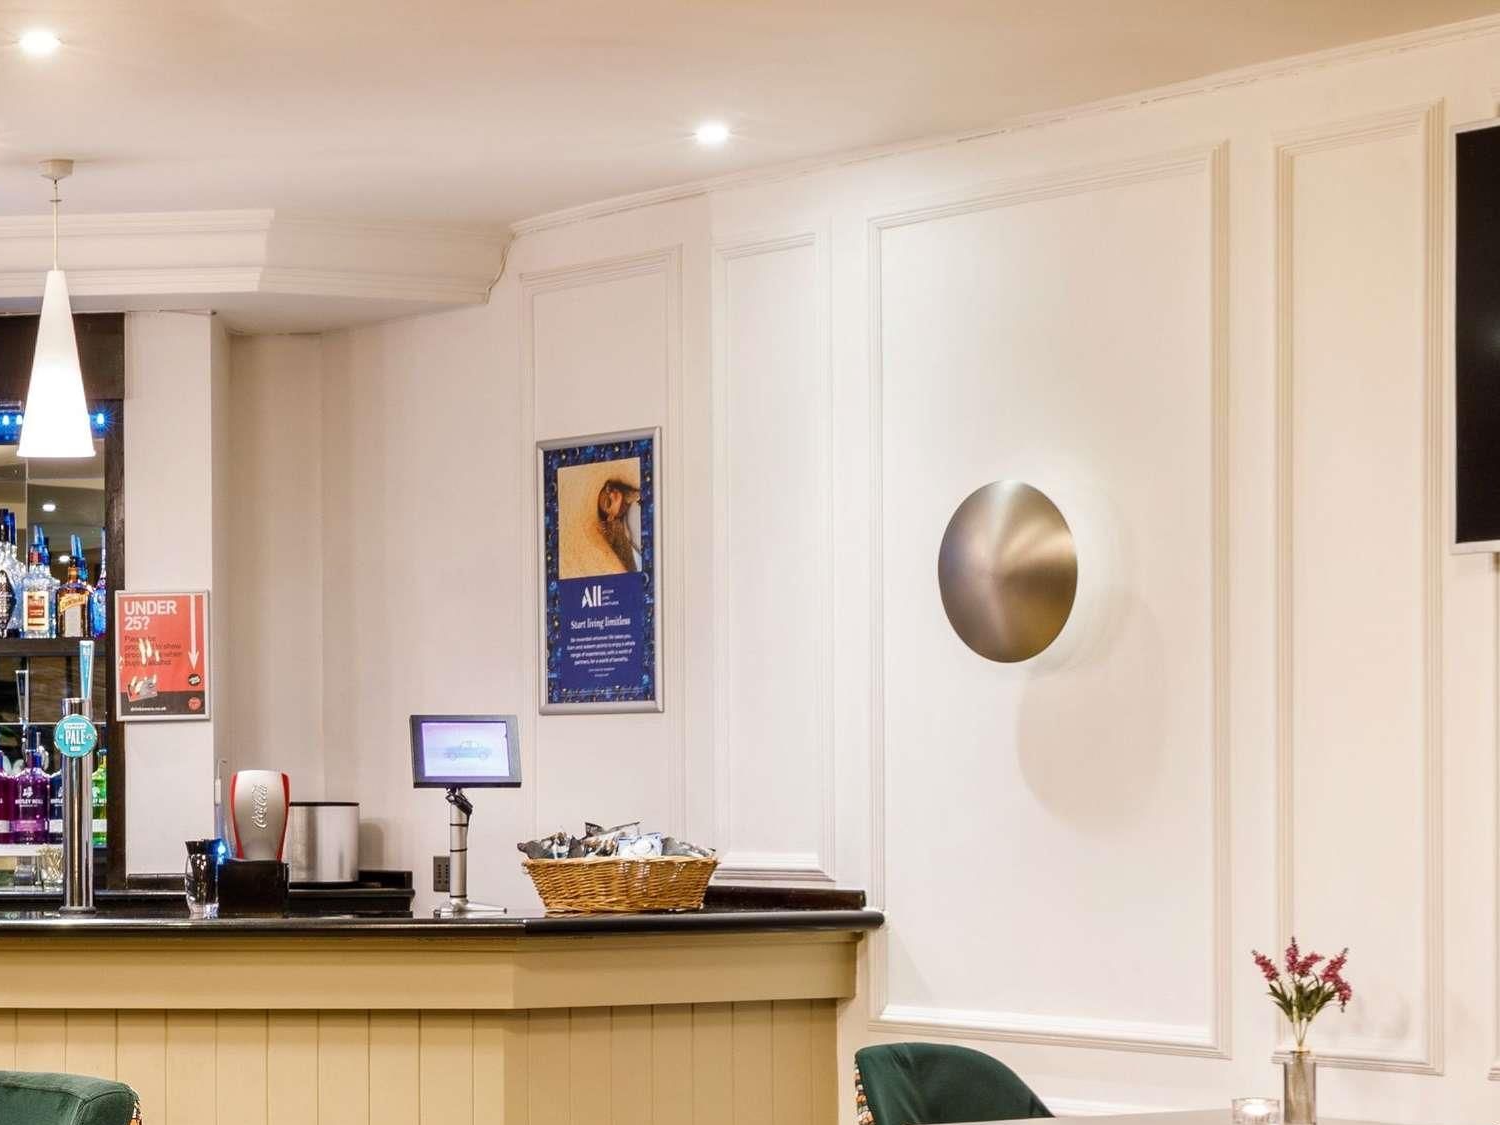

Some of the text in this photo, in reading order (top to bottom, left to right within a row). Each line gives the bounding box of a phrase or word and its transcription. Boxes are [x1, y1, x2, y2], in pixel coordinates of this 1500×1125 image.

[124, 600, 177, 615] UNDER
[124, 616, 150, 631] 25?
[65, 729, 86, 745] PALE
